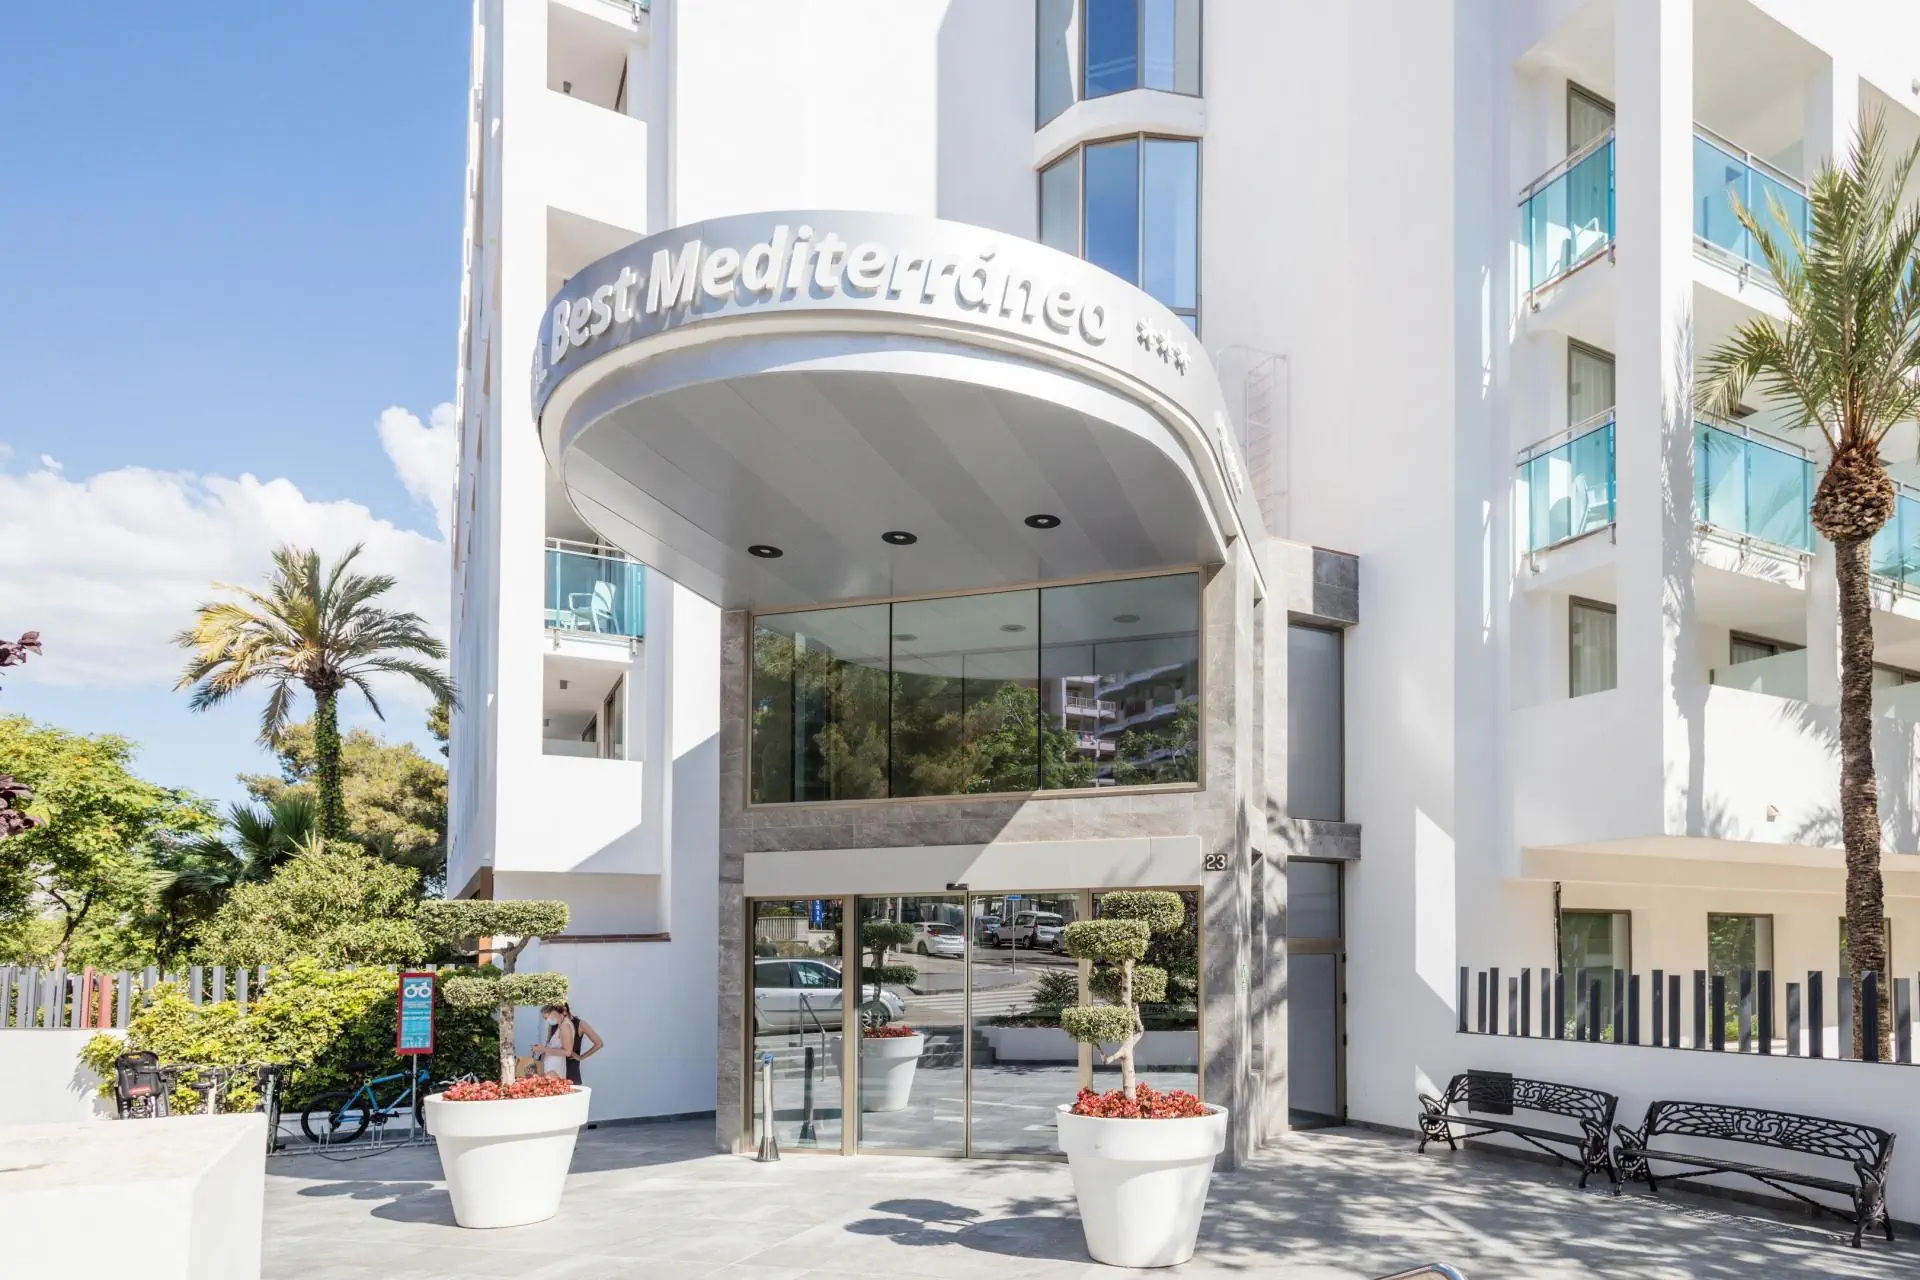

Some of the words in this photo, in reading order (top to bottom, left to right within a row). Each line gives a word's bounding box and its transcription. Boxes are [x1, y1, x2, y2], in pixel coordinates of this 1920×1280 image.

[550, 266, 637, 365] Best
[645, 224, 1108, 344] Mediterráneo
[1206, 854, 1226, 870] 23
